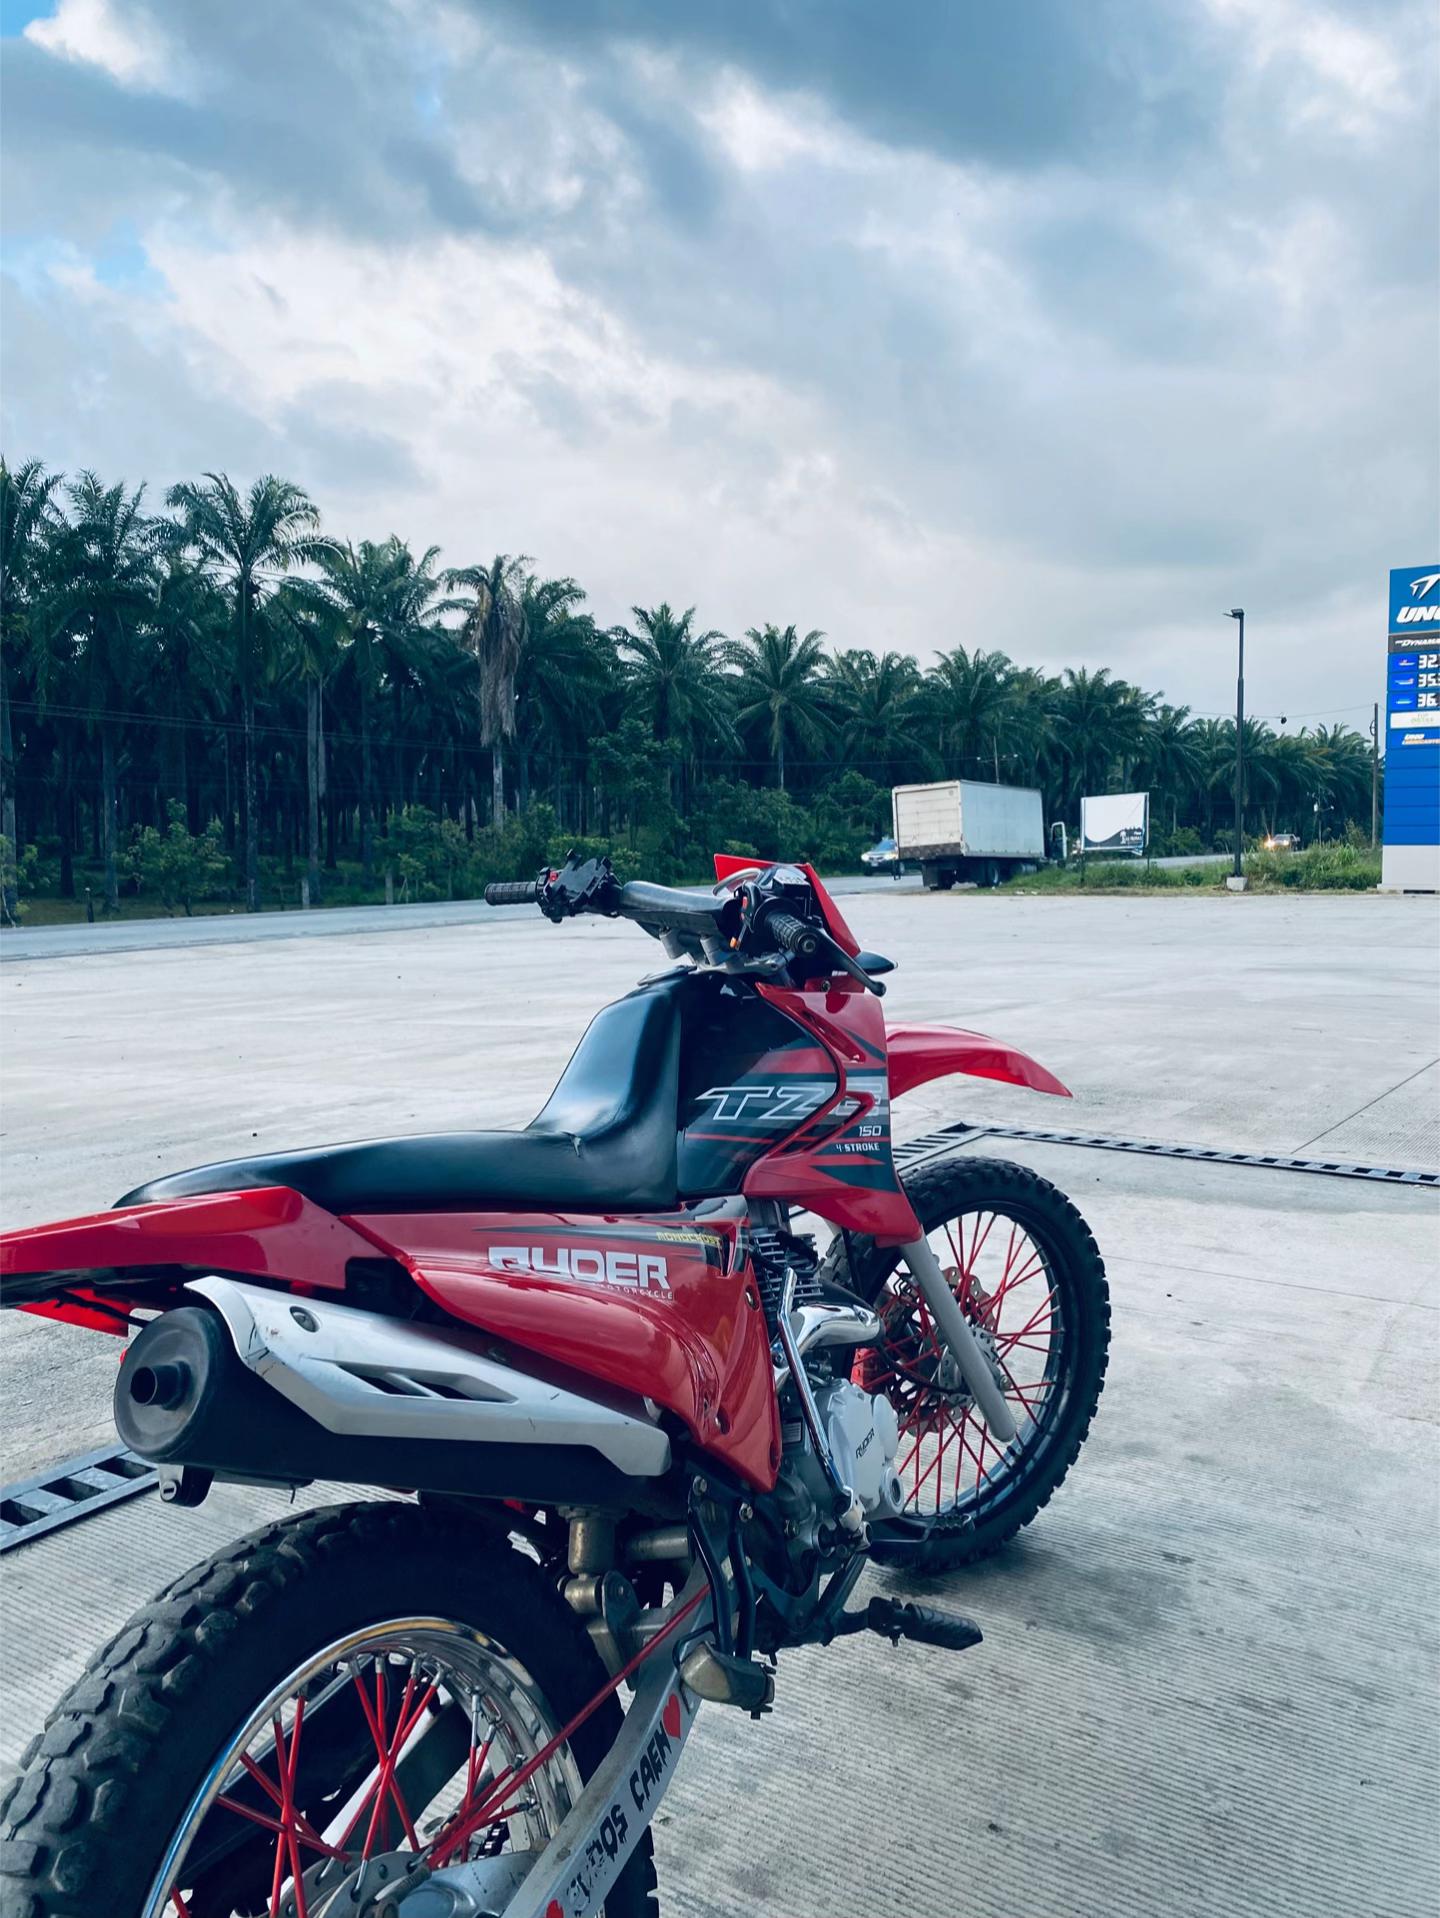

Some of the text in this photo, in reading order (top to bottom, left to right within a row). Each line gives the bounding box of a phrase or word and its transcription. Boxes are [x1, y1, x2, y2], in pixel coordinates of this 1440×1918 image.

[859, 1125, 882, 1137] 150
[488, 1246, 671, 1290] RYDER
[629, 1721, 672, 1813] CAEN
